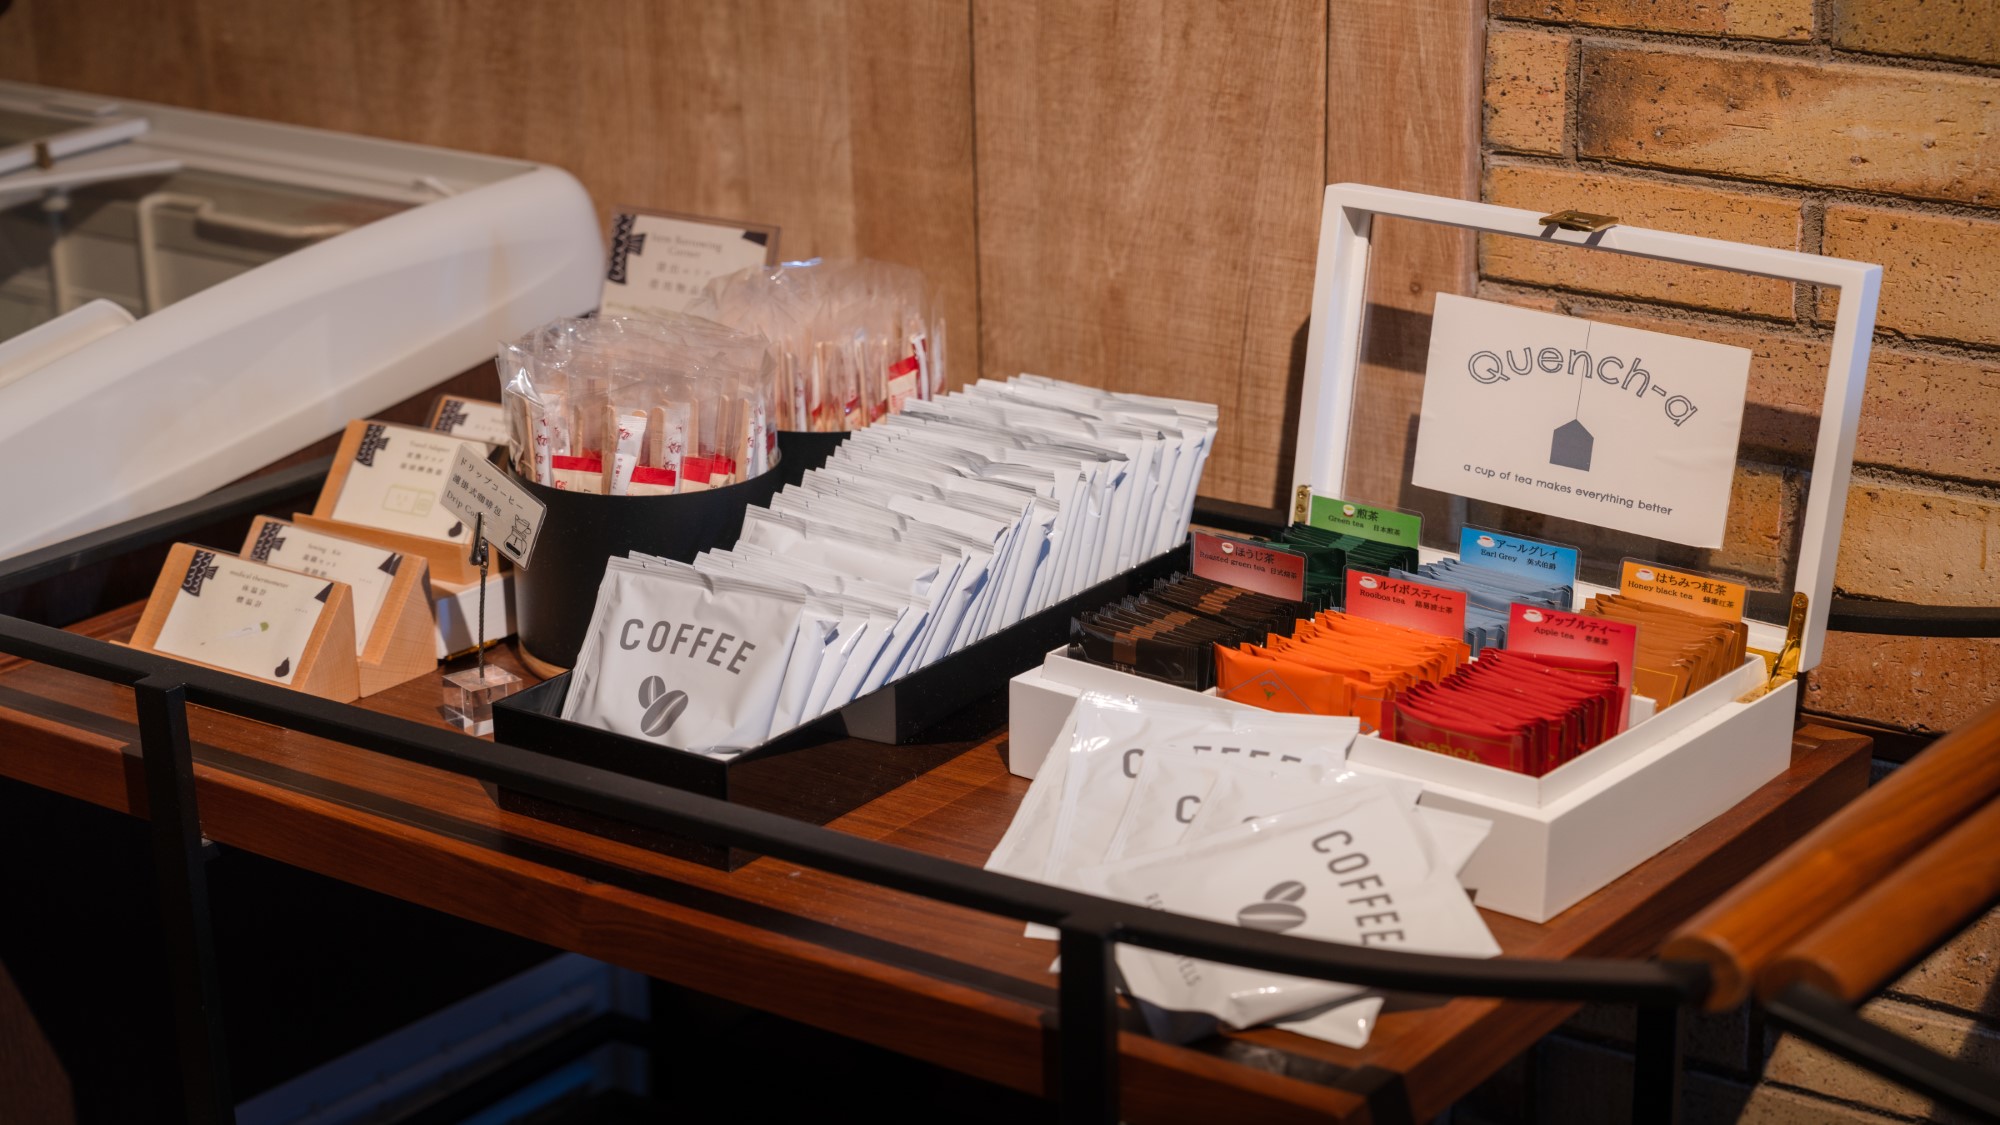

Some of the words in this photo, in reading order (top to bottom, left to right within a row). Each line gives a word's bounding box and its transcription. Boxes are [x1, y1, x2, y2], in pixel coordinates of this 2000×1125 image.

[1468, 347, 1698, 427] Quench-a
[460, 457, 523, 510] ドリップコーヒー
[1463, 463, 1471, 471] a
[1474, 465, 1496, 479] cup
[1499, 470, 1511, 481] of
[1515, 473, 1532, 485] tea
[1536, 476, 1572, 494] makes
[1575, 487, 1634, 509] everything
[1638, 498, 1673, 516] better
[446, 490, 463, 508] Drip
[1328, 514, 1351, 525] Green
[1352, 520, 1364, 528] tea
[1357, 508, 1379, 521] 煎茶
[1235, 546, 1275, 564] ほうじ茶
[1480, 548, 1497, 558] Earl
[1498, 553, 1517, 563] Grey
[1496, 539, 1558, 560] アールグレイ
[1199, 551, 1229, 563] Roasted
[1231, 559, 1252, 569] green
[1253, 564, 1266, 572] tea
[1378, 580, 1453, 601] ルイボスティー
[1627, 580, 1654, 592] Honey
[1656, 586, 1677, 597] black
[1680, 592, 1693, 600] tea
[1656, 572, 1727, 596] はちみつ紅茶
[1359, 589, 1391, 602] Rooibos
[1392, 596, 1405, 605] tea
[1534, 626, 1559, 637] Apple
[1561, 631, 1574, 640] tea
[1544, 613, 1621, 635] アップルティー
[619, 618, 756, 675] COFFEE
[1311, 830, 1405, 946] COFFEE
